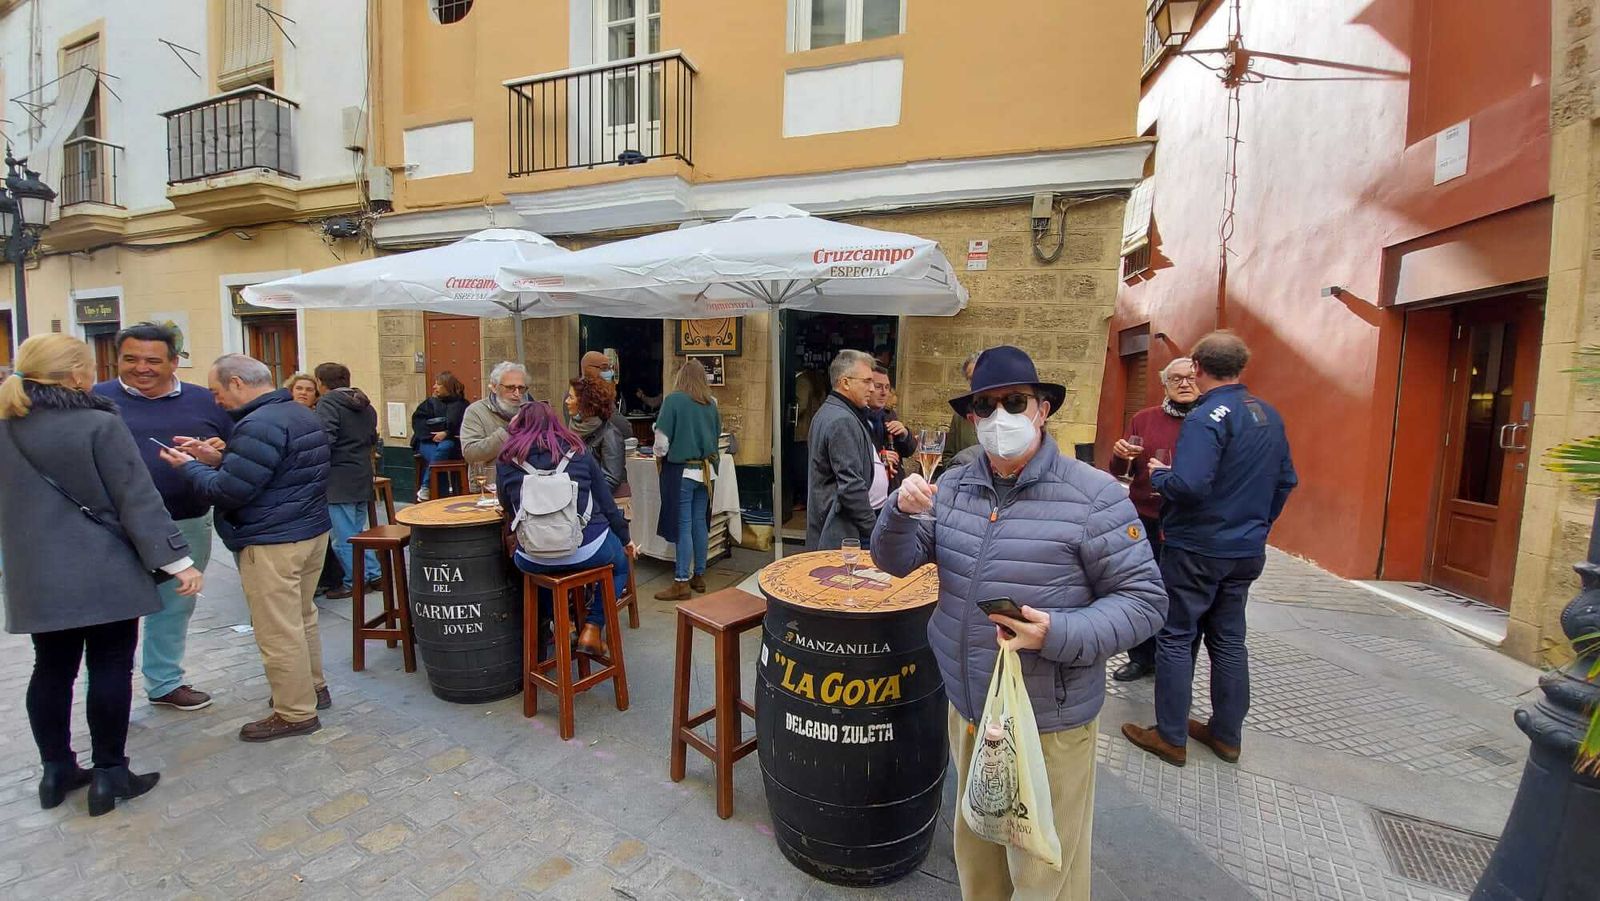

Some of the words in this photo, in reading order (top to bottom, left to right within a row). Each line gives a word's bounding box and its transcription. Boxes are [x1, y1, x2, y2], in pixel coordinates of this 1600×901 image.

[813, 247, 915, 265] Cruzcampo
[830, 266, 889, 278] ESPECIAL
[446, 277, 499, 291] Cruzcamp
[423, 563, 464, 582] VIÑA
[433, 584, 451, 593] DEL
[415, 602, 482, 620] CARMEN
[443, 622, 484, 635] JOVEN
[795, 633, 892, 655] MANZANILLA
[785, 712, 838, 743] DELGADO
[841, 722, 894, 744] ZULETA
